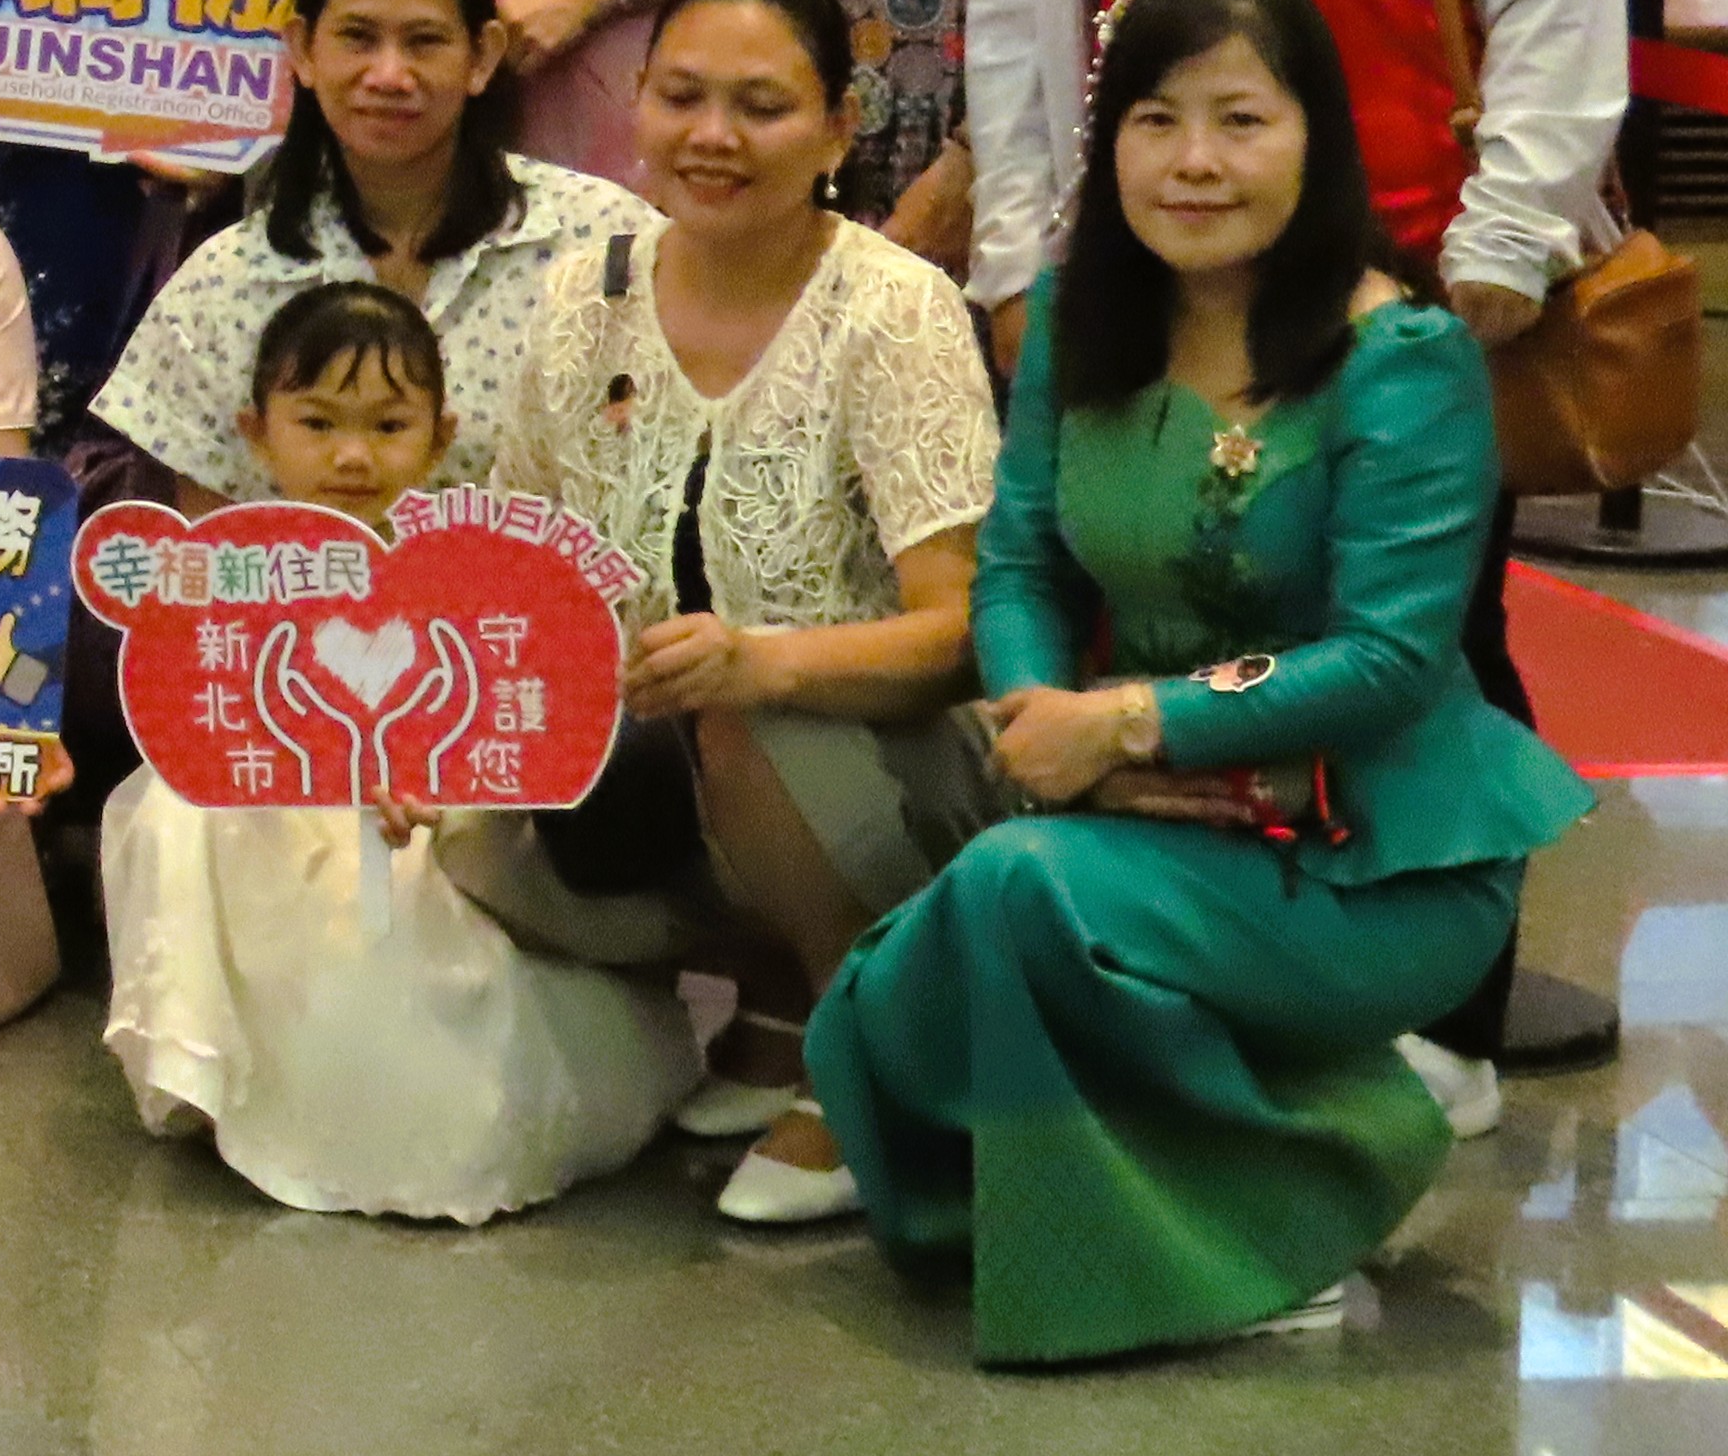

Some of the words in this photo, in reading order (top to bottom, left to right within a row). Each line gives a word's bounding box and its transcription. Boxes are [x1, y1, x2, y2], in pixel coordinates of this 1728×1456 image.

[81, 85, 202, 119] Registration
[207, 101, 268, 125] Office
[94, 536, 370, 602] 幸福新住民
